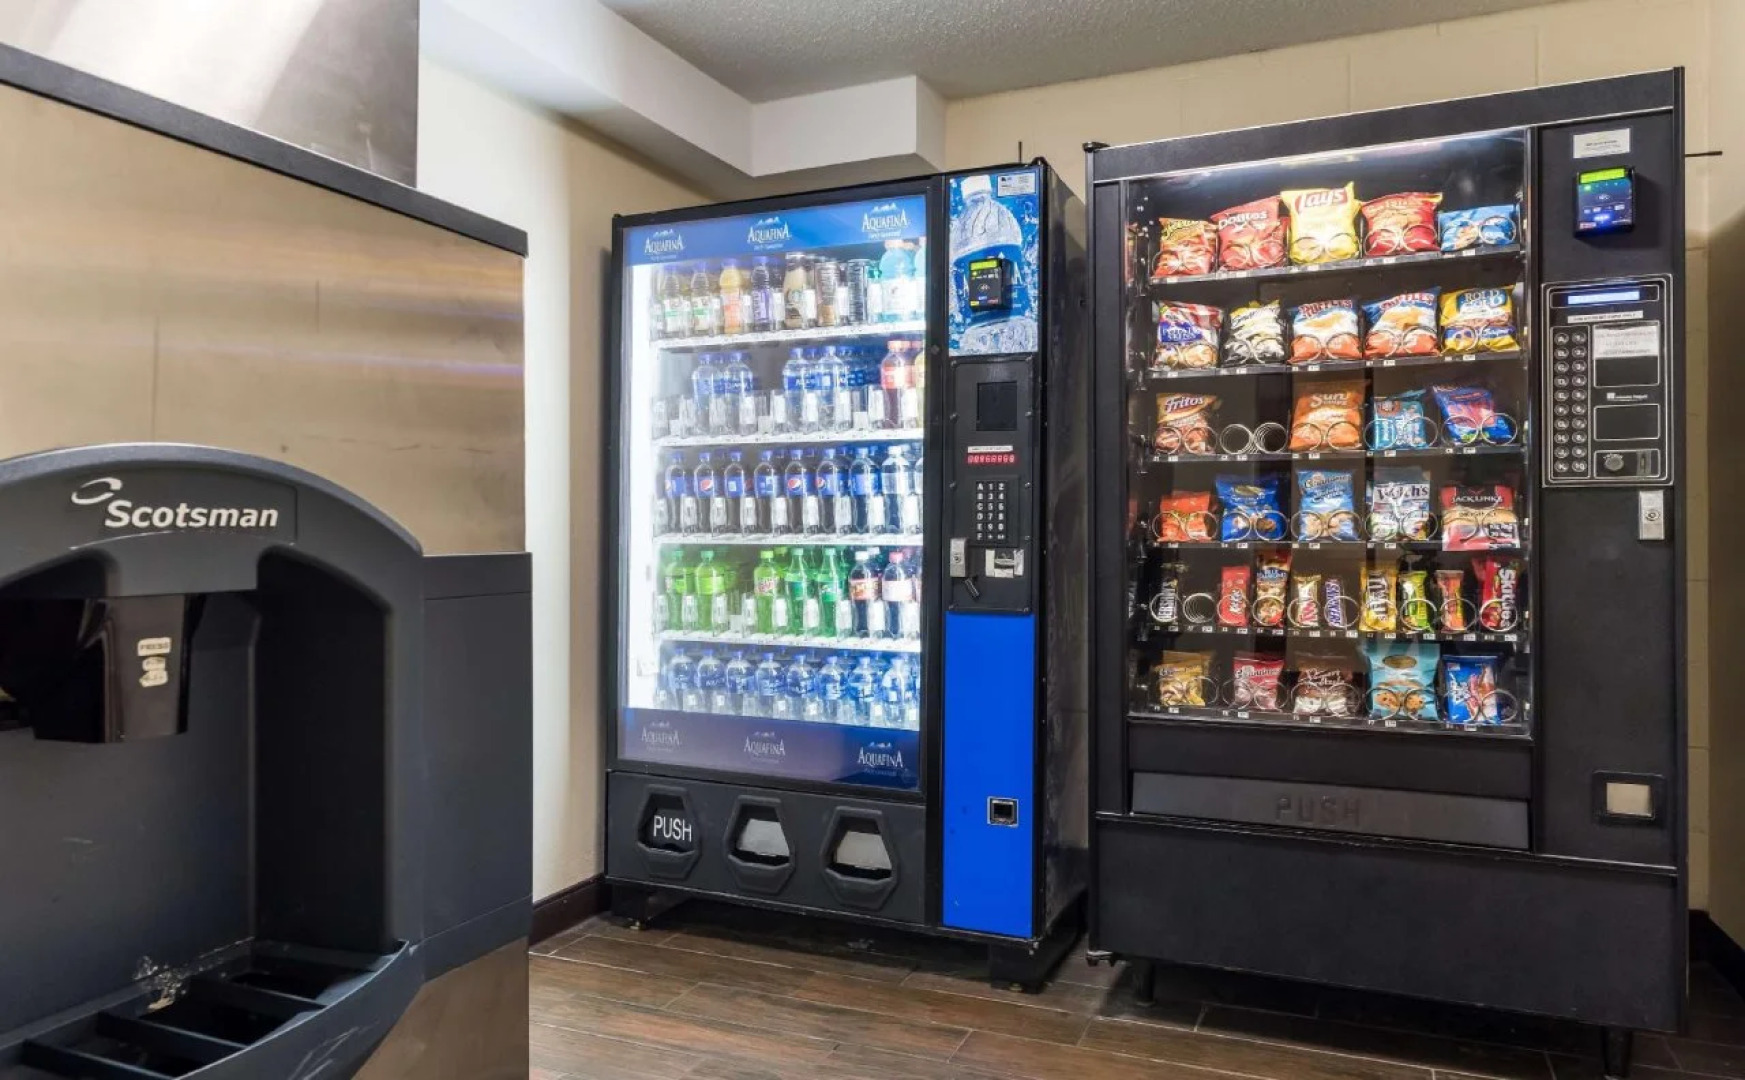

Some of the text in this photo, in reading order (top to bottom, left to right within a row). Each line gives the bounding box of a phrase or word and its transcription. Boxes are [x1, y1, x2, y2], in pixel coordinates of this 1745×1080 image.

[862, 210, 908, 231] AQUAFINA
[1219, 211, 1267, 229] Doritos
[748, 223, 790, 243] AQUAFINA
[645, 235, 684, 255] AQUAFINA
[1466, 289, 1499, 301] ROLD
[1166, 396, 1203, 413] Fritos
[1310, 393, 1348, 407] Sun
[105, 500, 278, 528] Scotsman
[641, 727, 681, 744] AQUAFINA
[744, 738, 786, 756] AQUAFINA
[858, 748, 904, 768] AQUAFINA
[1276, 796, 1360, 827] PUSH
[653, 815, 692, 842] PUSH
